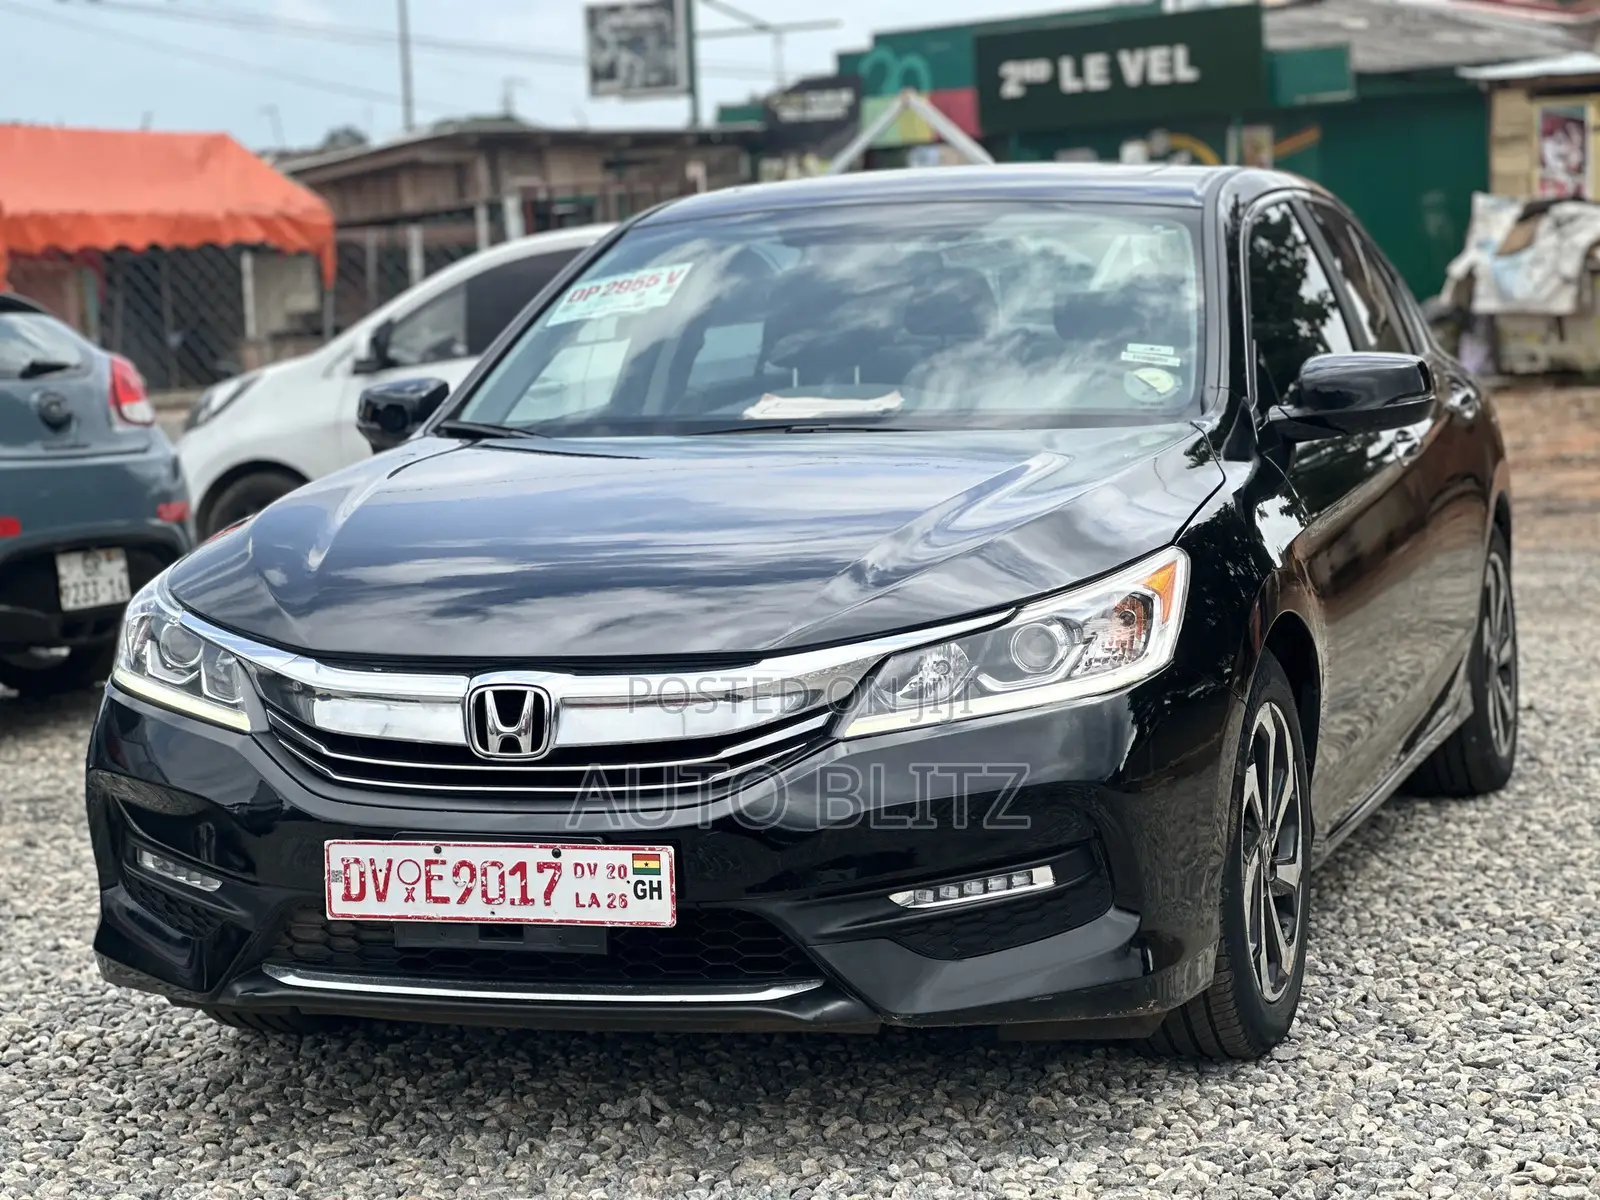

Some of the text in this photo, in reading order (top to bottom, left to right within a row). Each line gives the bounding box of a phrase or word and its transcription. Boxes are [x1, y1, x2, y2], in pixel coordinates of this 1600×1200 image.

[341, 857, 393, 902] DV
[573, 862, 628, 880] DV 20
[633, 879, 662, 901] GH
[575, 892, 628, 909] LA 26
